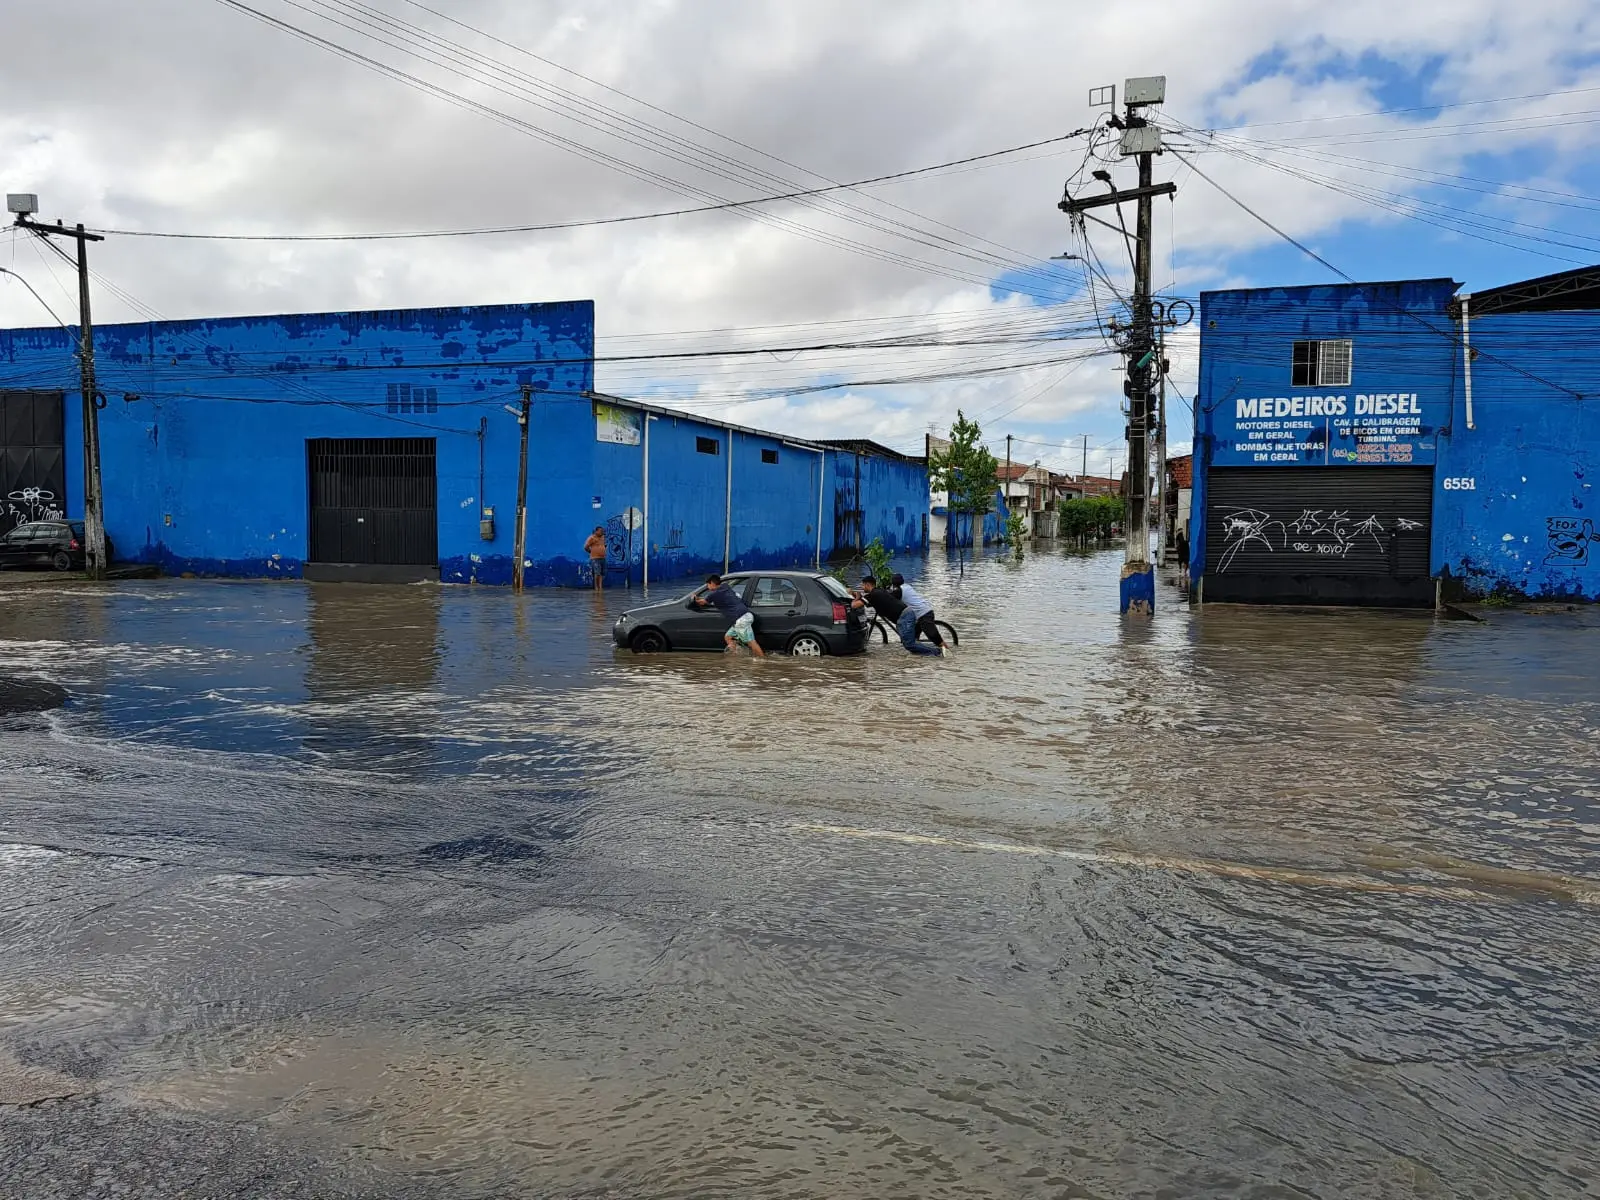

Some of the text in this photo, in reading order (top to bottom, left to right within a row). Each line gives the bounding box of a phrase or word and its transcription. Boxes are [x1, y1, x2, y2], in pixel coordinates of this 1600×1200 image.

[1236, 393, 1422, 418] MEDEIROS DIESEL
[1236, 420, 1315, 430] MOTORES DIESEL
[1333, 417, 1421, 427] CAV. E CALIBRAGEM
[1248, 431, 1295, 440] EM GERAL
[1339, 427, 1420, 436] DE BICOS EM GERAL
[1358, 435, 1397, 443] TURBINAS
[1235, 442, 1325, 452] BOMBAS INJETORAS
[1254, 453, 1299, 461] EM GERAL
[1443, 477, 1476, 490] 6551
[1555, 520, 1577, 529] FOX
